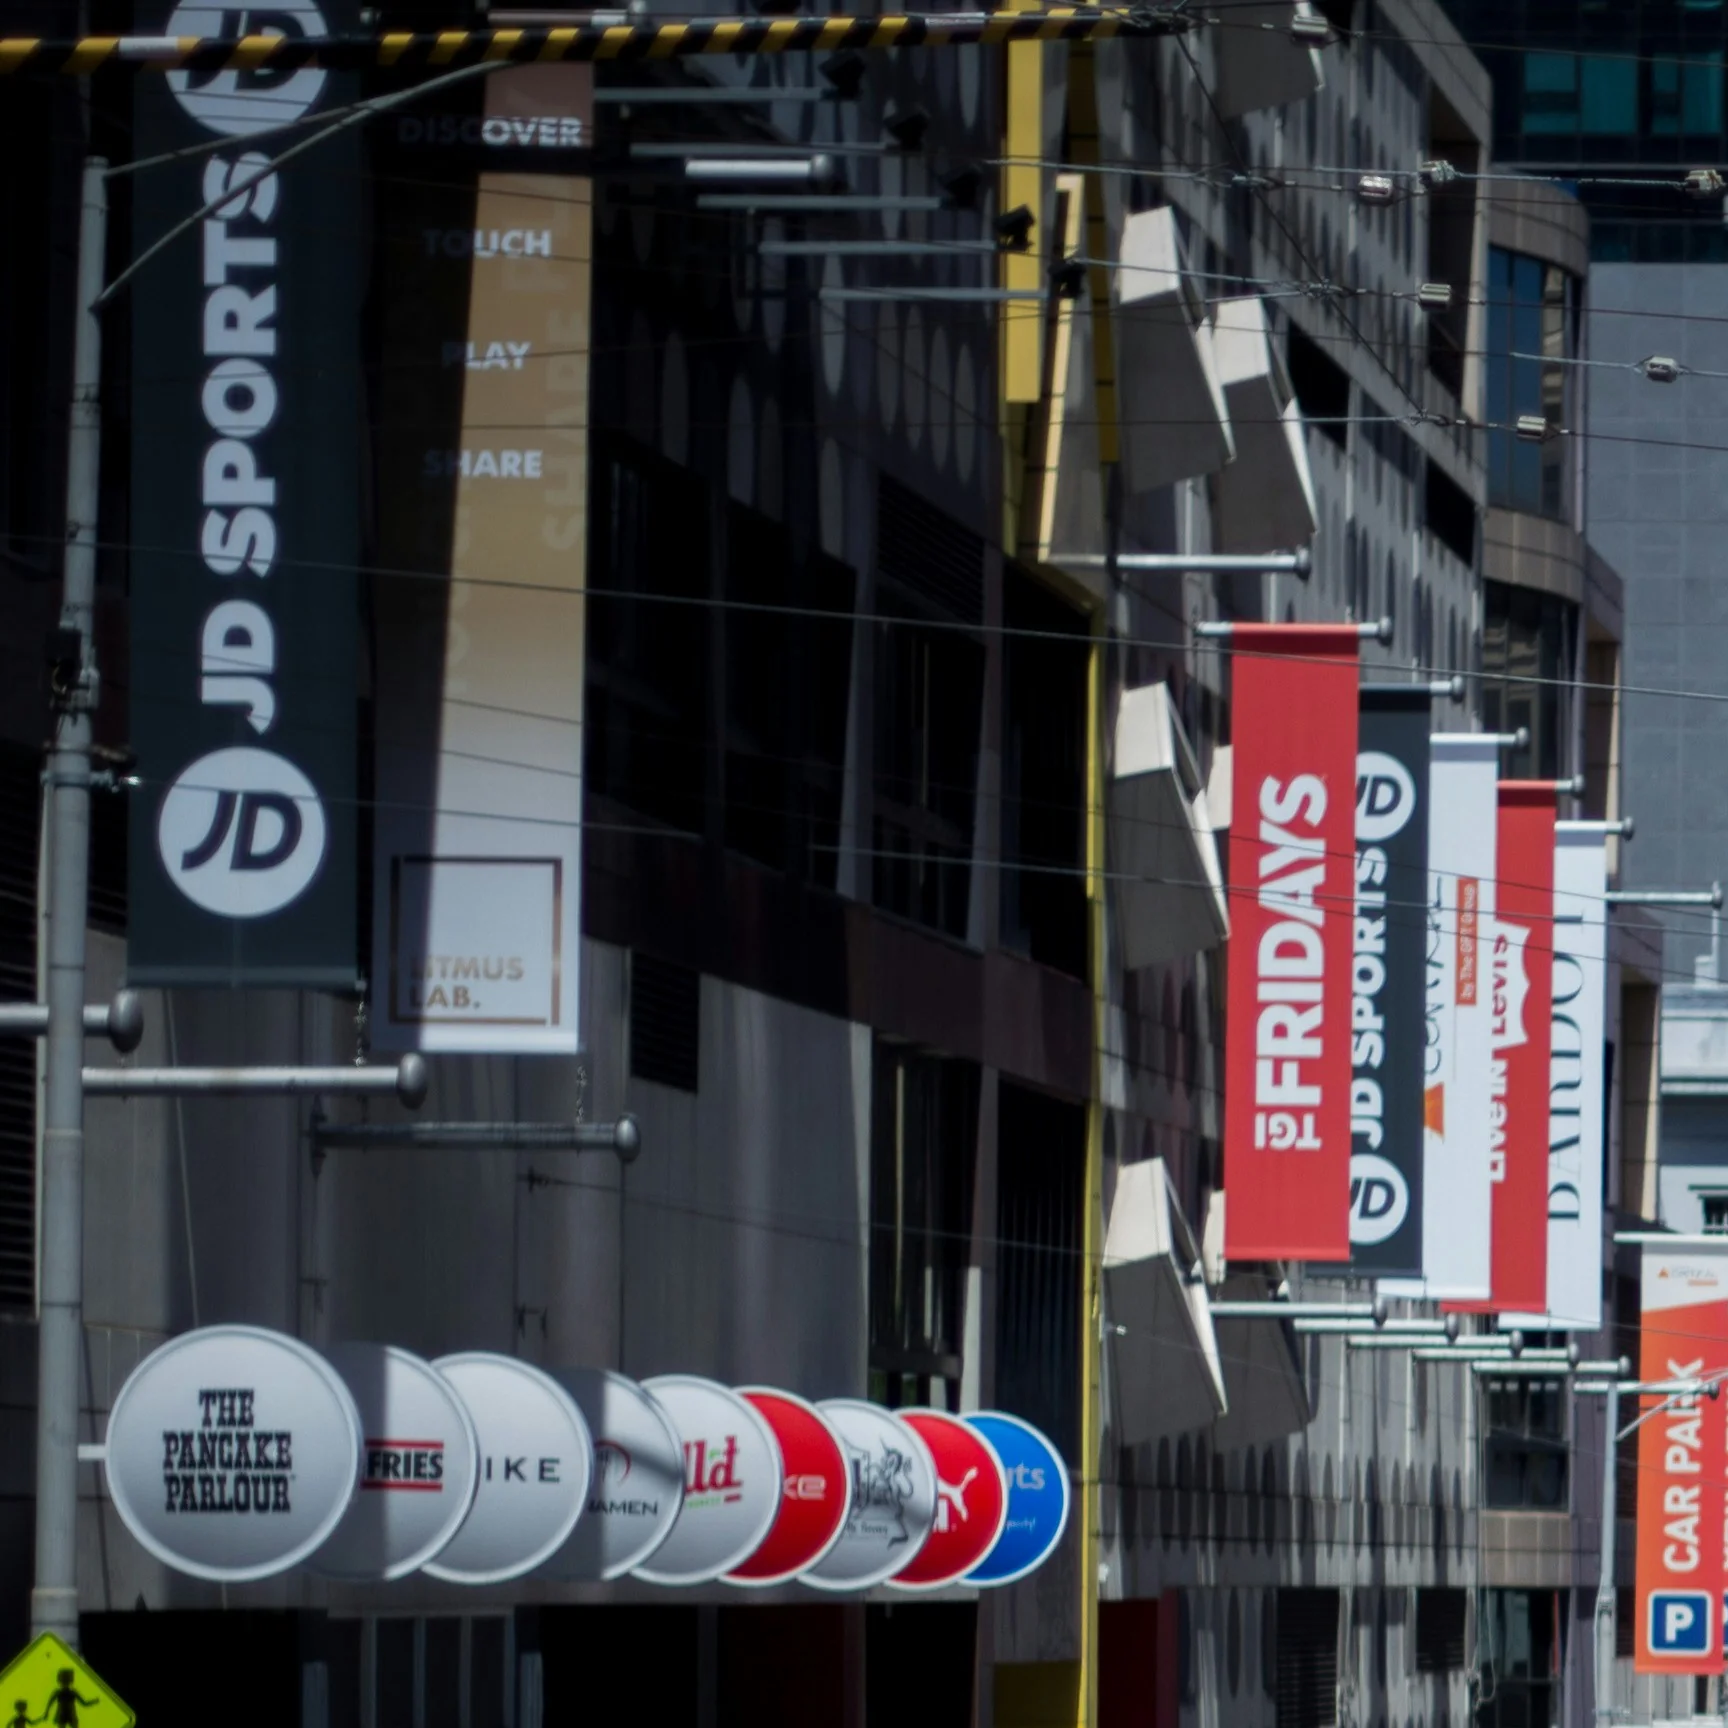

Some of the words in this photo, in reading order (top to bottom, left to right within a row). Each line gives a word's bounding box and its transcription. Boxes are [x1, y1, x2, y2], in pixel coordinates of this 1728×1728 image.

[397, 118, 582, 147] DISCOVER
[422, 229, 552, 258] TOUCH
[201, 151, 278, 578] SPORTS
[441, 342, 531, 370] PLAY
[422, 450, 543, 479] SHARE
[201, 599, 278, 735] JD
[182, 789, 302, 872] JD
[1256, 773, 1328, 1106] FRIDAYS
[1351, 846, 1387, 1069] SPORTS
[411, 956, 524, 981] LITMUS
[411, 986, 481, 1010] LAB.
[1351, 1077, 1384, 1150] JD
[199, 1389, 254, 1428] THE
[1665, 1358, 1704, 1474] PARK
[163, 1431, 292, 1470] PANCAKE
[367, 1451, 444, 1481] FRIES
[164, 1474, 292, 1513] PARLOUR
[1663, 1485, 1702, 1573] CAR
